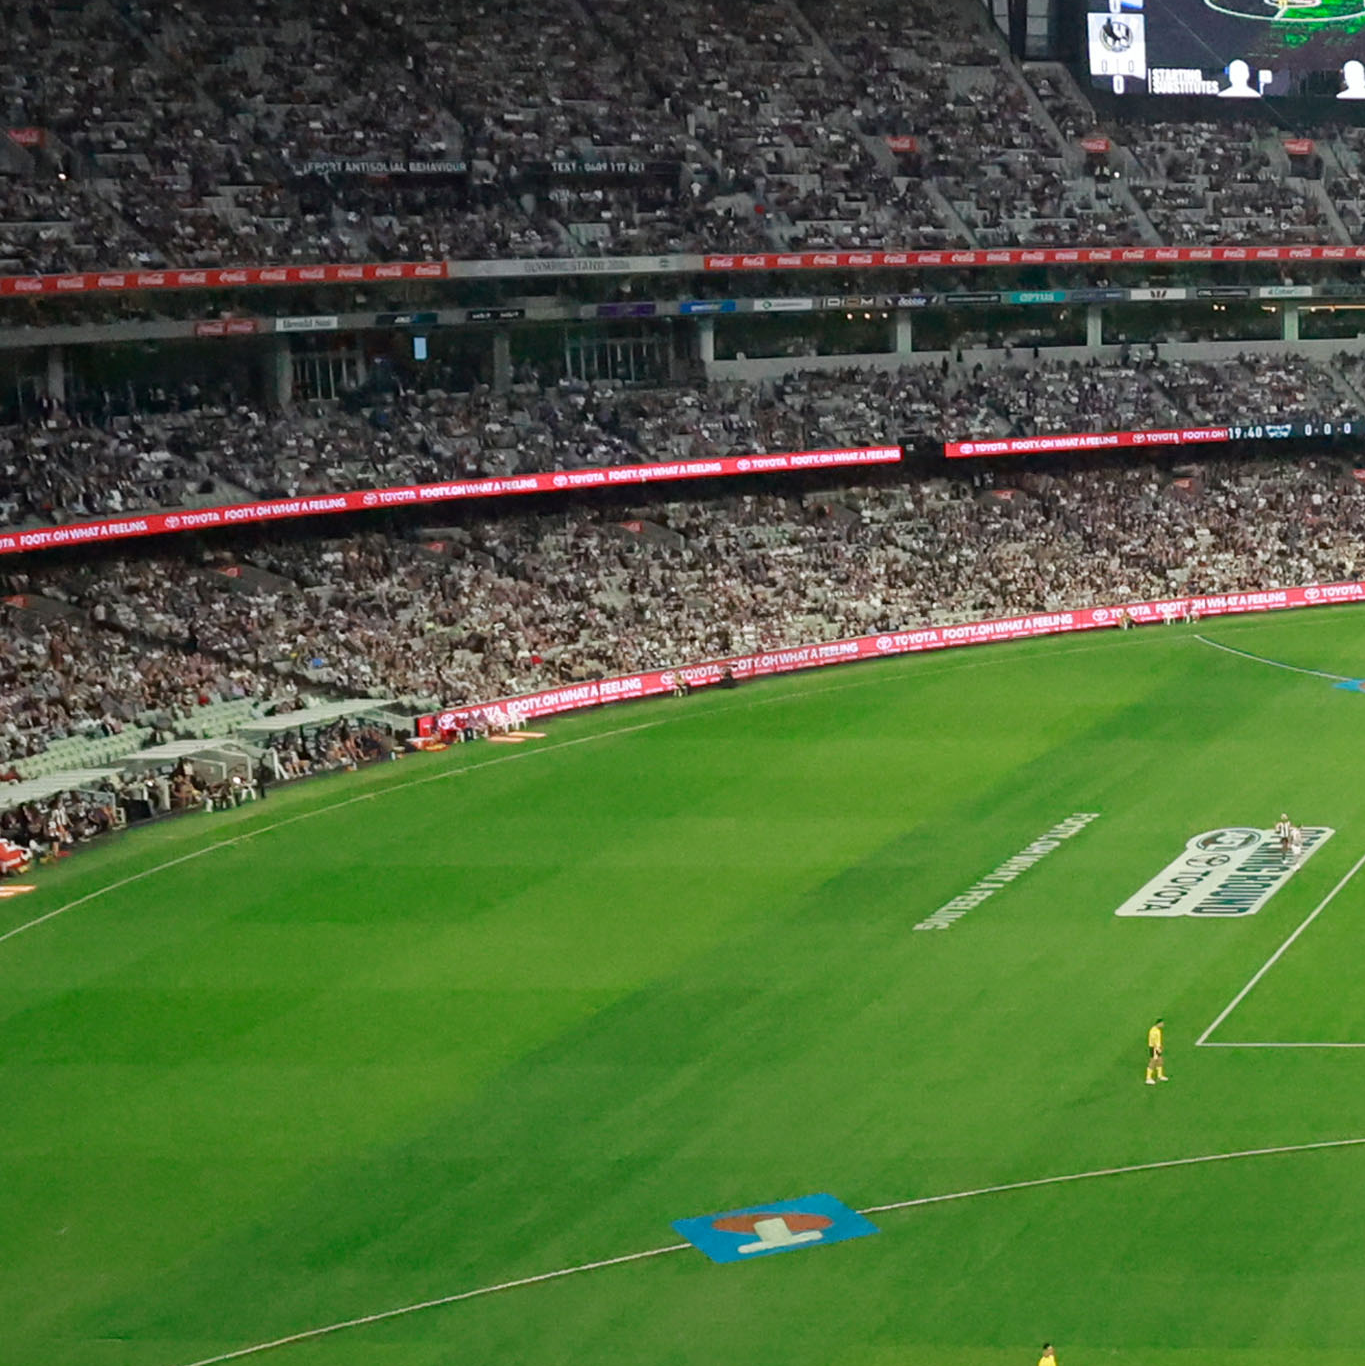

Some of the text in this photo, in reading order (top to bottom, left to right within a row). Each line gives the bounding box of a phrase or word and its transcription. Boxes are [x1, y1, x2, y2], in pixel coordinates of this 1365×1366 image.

[1152, 68, 1202, 81] STARTING
[1153, 80, 1219, 94] SUBSTITUTES
[1228, 426, 1262, 438] 19:40
[976, 442, 1007, 452] TOYOTA
[183, 511, 218, 525] TOYOTA
[272, 502, 299, 514] WHAT
[309, 497, 345, 510] FEELING
[1323, 584, 1361, 597] TOYOTA
[895, 630, 936, 646] TOYOTA
[995, 619, 1022, 632] WHAT
[1032, 613, 1072, 627] FEELING
[1136, 870, 1211, 911] TOYOTA
[1190, 874, 1282, 913] ROUND
